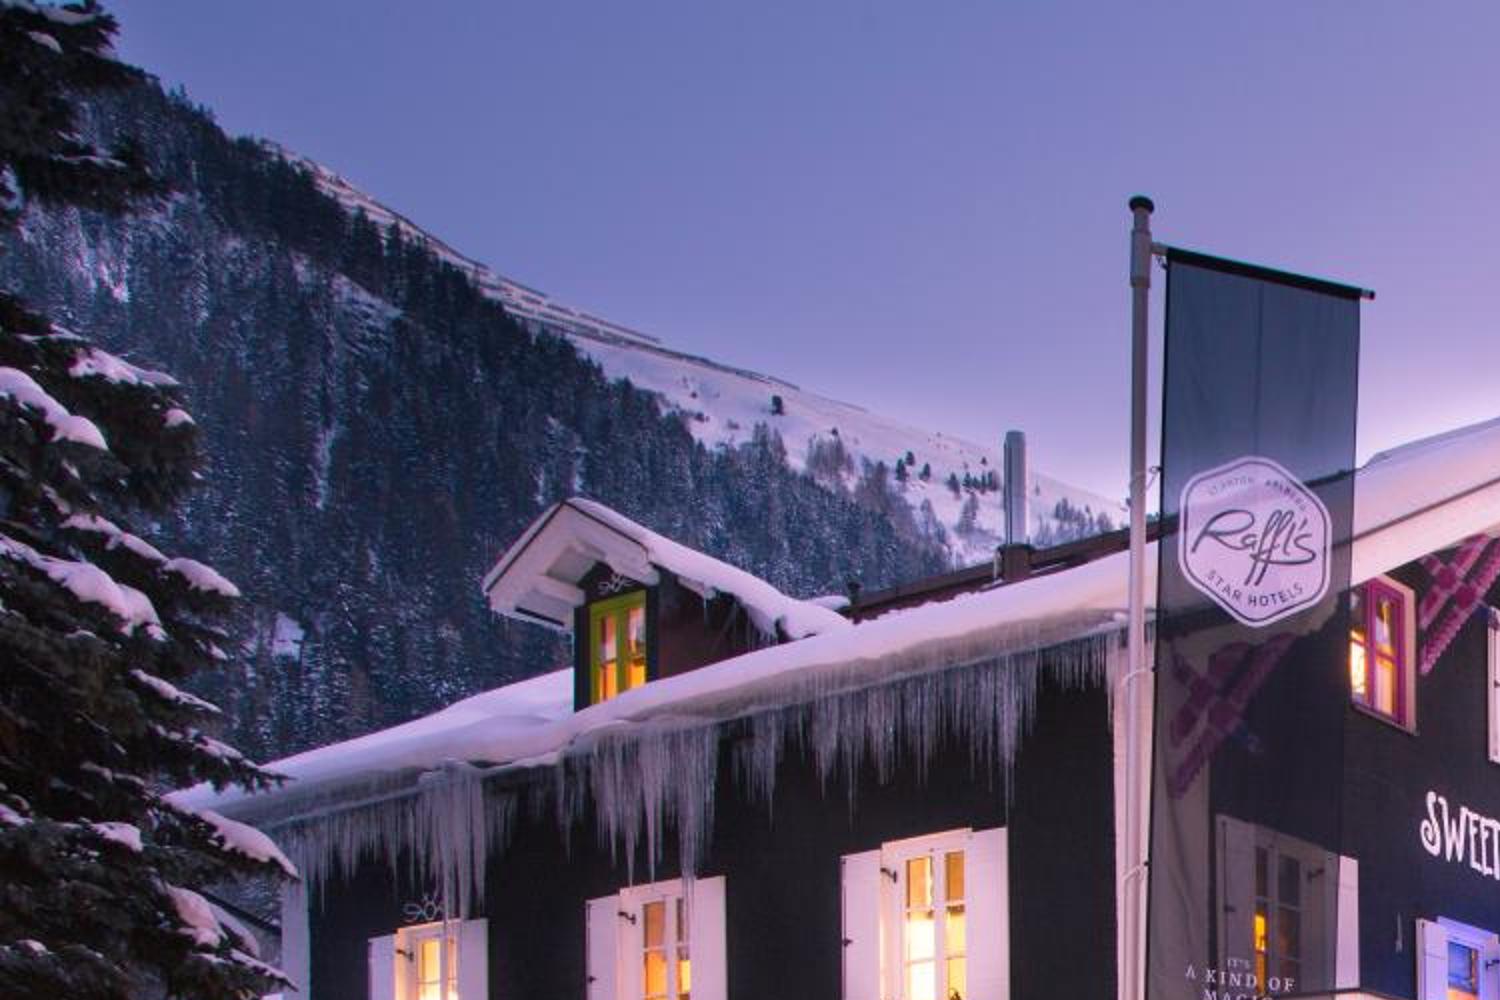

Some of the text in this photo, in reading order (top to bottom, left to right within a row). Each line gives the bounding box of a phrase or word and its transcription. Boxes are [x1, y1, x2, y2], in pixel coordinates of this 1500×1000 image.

[1207, 569, 1303, 607] STAR HOTELS
[1185, 964, 1295, 993] A KIND OF
